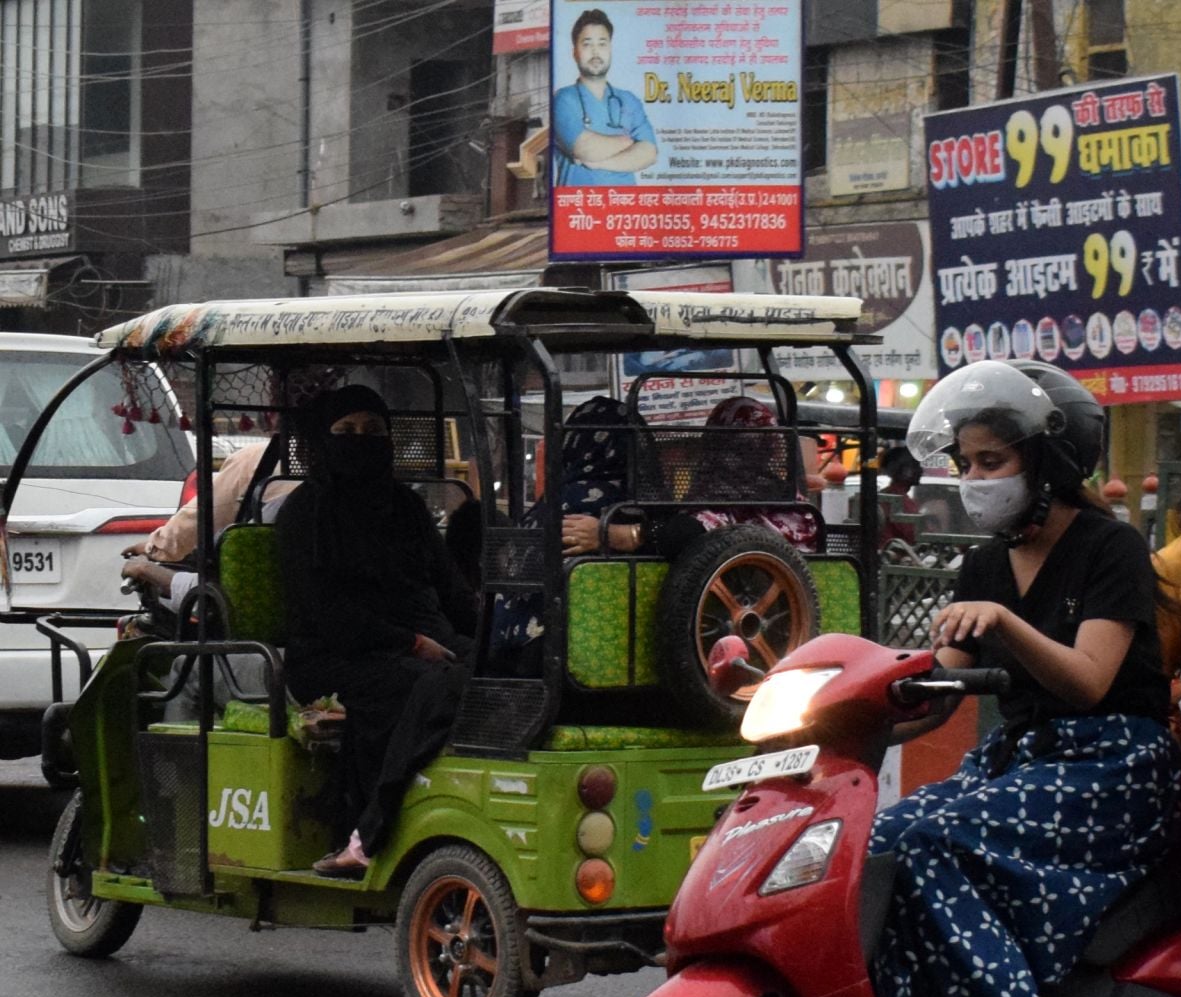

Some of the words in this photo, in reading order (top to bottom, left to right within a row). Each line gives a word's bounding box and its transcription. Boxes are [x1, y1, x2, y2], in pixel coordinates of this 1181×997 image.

[644, 72, 673, 104] Dr.
[677, 72, 735, 109] Neeraj
[739, 72, 798, 104] Verma
[1072, 91, 1100, 127] की
[1103, 91, 1145, 124] तरफ
[1147, 82, 1167, 117] से
[930, 131, 1005, 190] STORE
[1006, 104, 1074, 189] 99
[28, 194, 69, 234] SONS
[608, 189, 636, 207] निकट
[638, 193, 660, 207] शहर
[662, 188, 704, 207] कोतवाली
[950, 207, 987, 240] आपके
[988, 209, 1014, 236] शहर
[1016, 201, 1029, 232] में
[1116, 188, 1132, 219] के
[606, 213, 696, 232] 8737031555,
[700, 213, 788, 231] 9452317836
[615, 232, 636, 248] फोन
[937, 254, 998, 307] प्रत्येक
[1003, 253, 1079, 299] आइटम
[1083, 229, 1138, 300] 99
[1156, 235, 1181, 289] में
[12, 551, 54, 572] 9531
[780, 751, 811, 773] 1287
[208, 787, 271, 832] JSA
